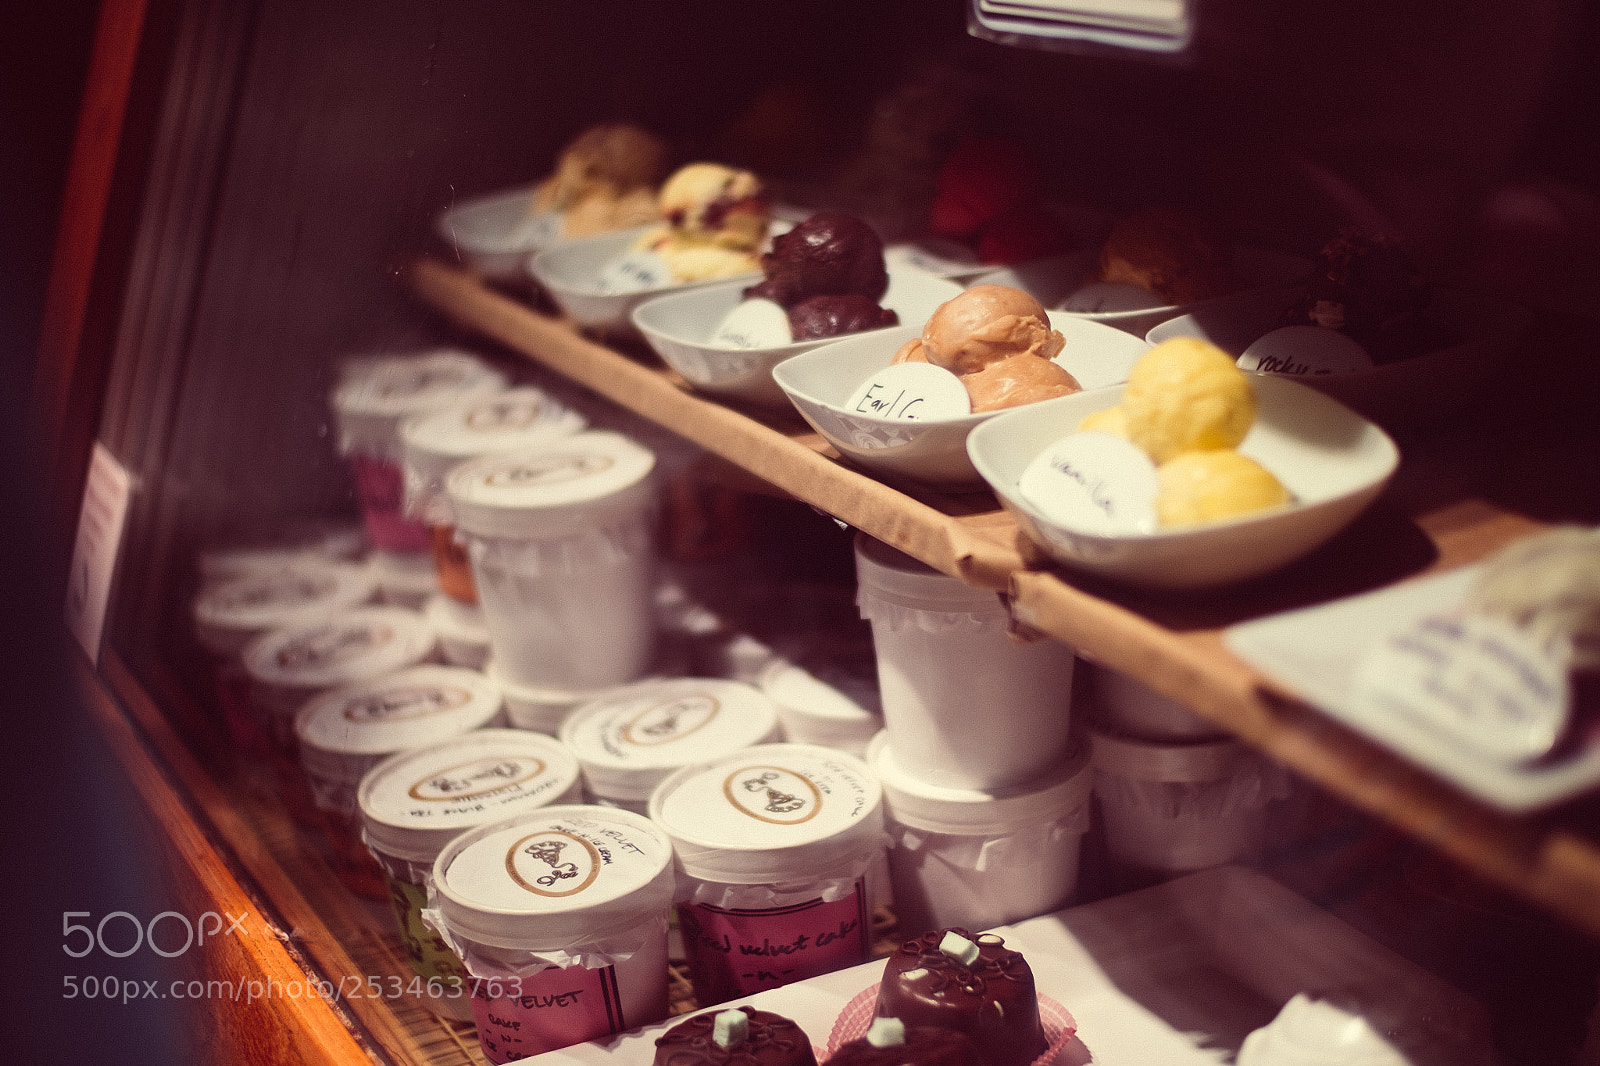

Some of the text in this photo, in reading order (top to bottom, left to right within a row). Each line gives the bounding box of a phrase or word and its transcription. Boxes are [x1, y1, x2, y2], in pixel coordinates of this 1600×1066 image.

[856, 384, 906, 417] Earl
[739, 934, 810, 956] velvet
[815, 918, 857, 948] cake
[506, 989, 585, 1010] VELVET
